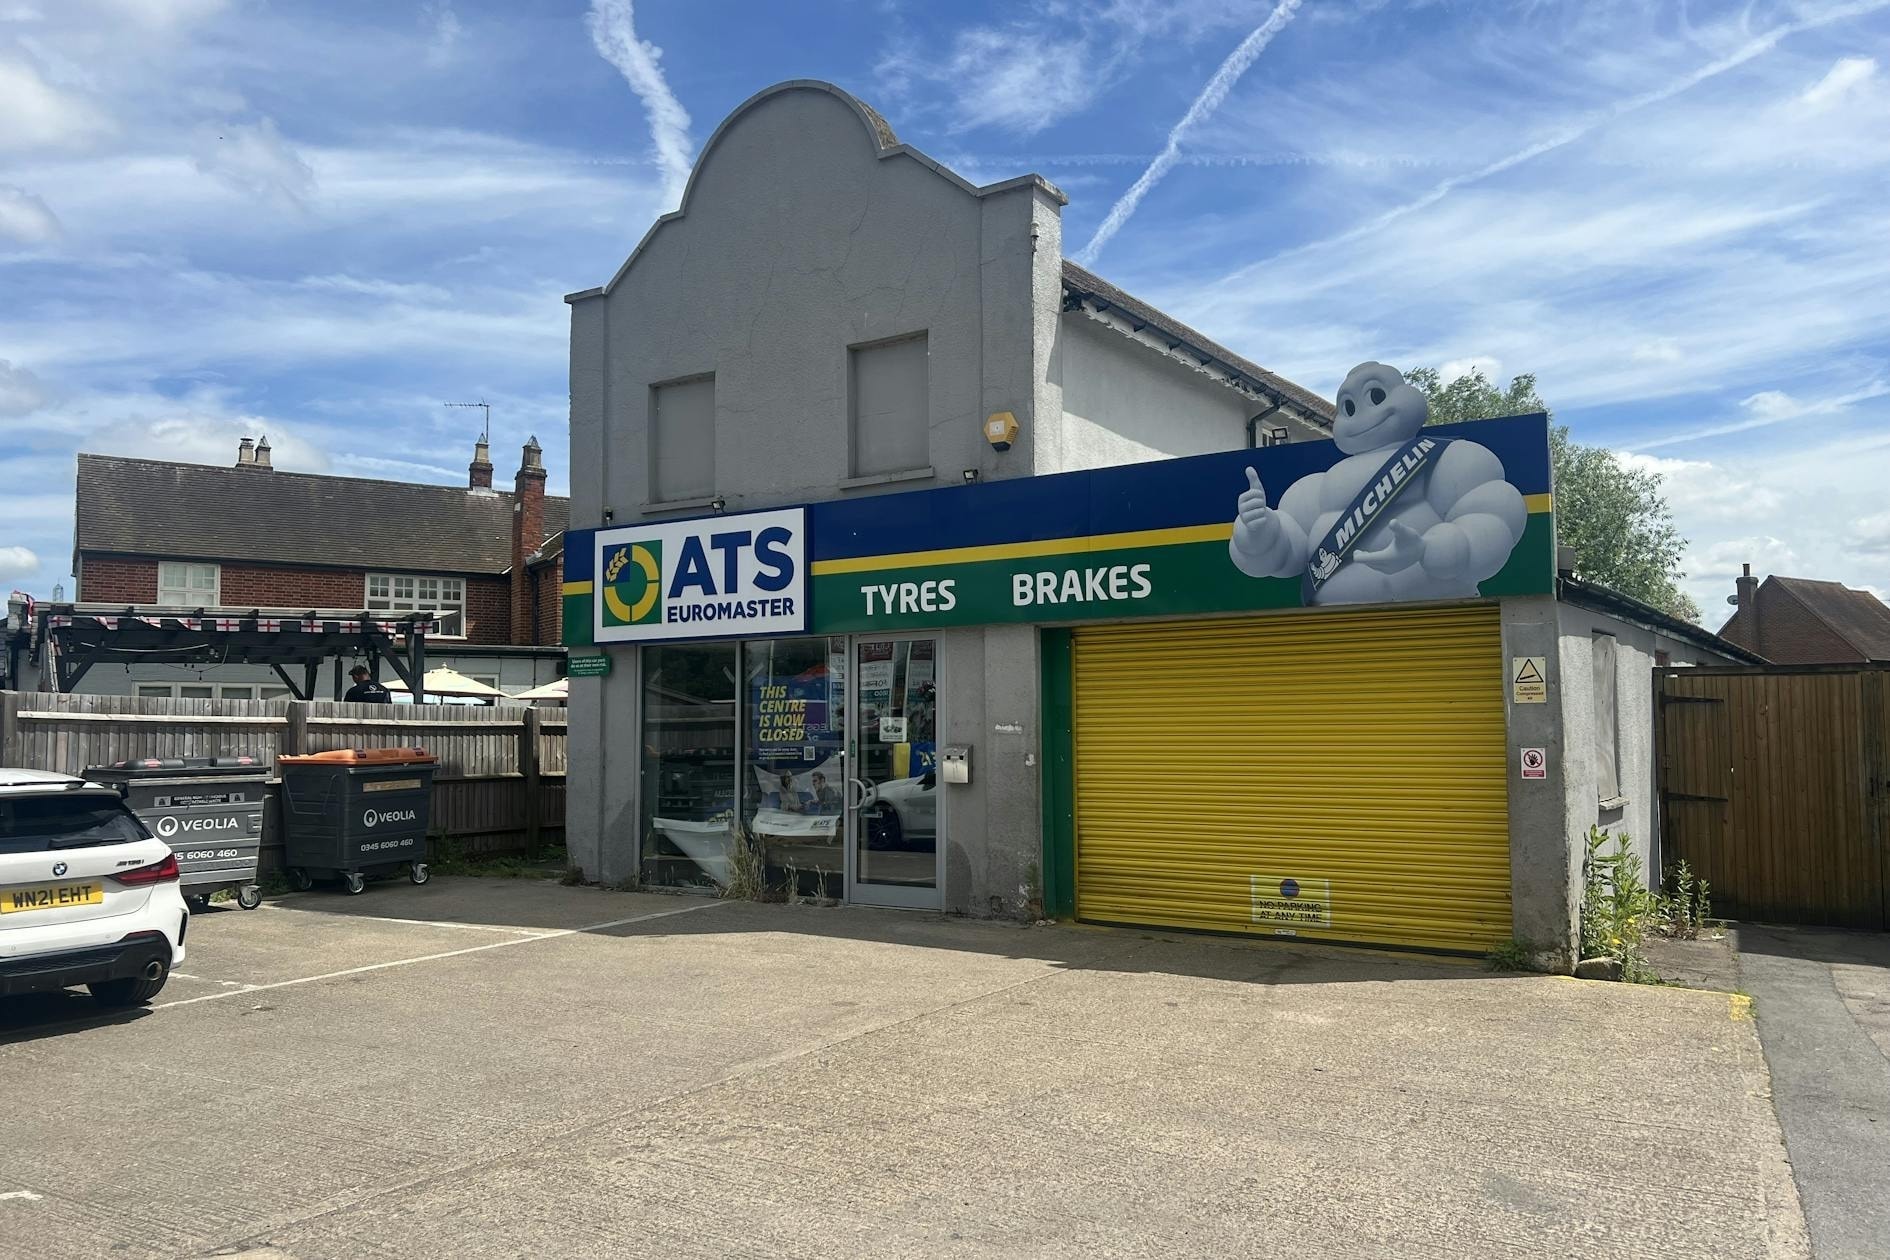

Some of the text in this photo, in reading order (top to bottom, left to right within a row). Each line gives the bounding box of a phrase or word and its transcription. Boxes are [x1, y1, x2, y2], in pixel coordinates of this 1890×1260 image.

[1335, 439, 1436, 550] MICHELIN
[667, 526, 795, 599] ATS
[860, 563, 1152, 616] TYRES BRAKES
[667, 597, 794, 623] EUROMASTER
[759, 685, 787, 699] THIS
[759, 699, 807, 713] CENTRE
[758, 714, 771, 727] IS
[773, 713, 806, 727] NOW
[759, 728, 805, 742] CLOSED
[379, 810, 416, 823] VEOLIA
[181, 817, 239, 832] VEOLIA
[361, 838, 413, 852] 0345 6060 460
[186, 850, 214, 859] 6060
[216, 849, 238, 857] 460
[12, 885, 92, 908] WN21 EHT
[1259, 901, 1323, 912] NO PARKING
[1260, 911, 1323, 923] AT ANY TIME
